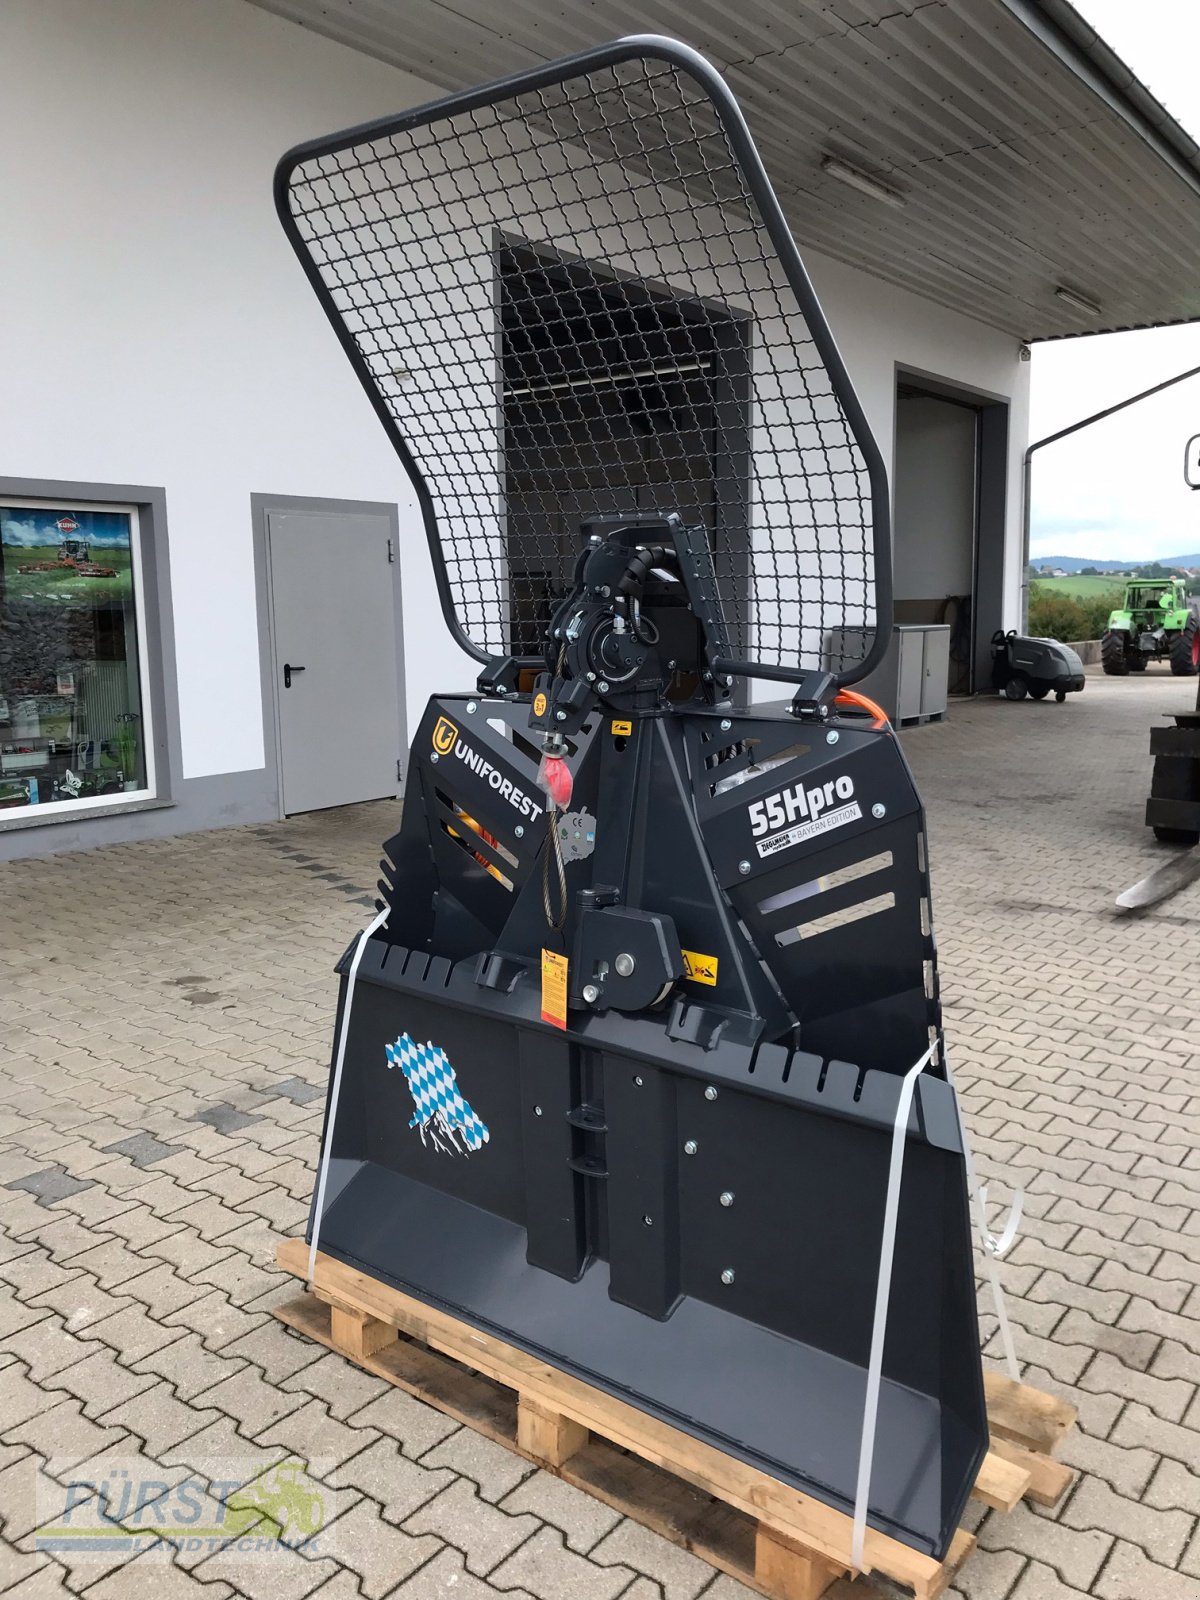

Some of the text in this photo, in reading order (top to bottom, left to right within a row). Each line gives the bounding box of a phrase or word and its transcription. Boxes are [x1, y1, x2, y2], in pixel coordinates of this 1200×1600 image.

[454, 739, 543, 822] UNIFOREST
[572, 817, 583, 828] CE
[748, 775, 854, 837] 55Hpro
[796, 807, 857, 839] BAYERN EDITION
